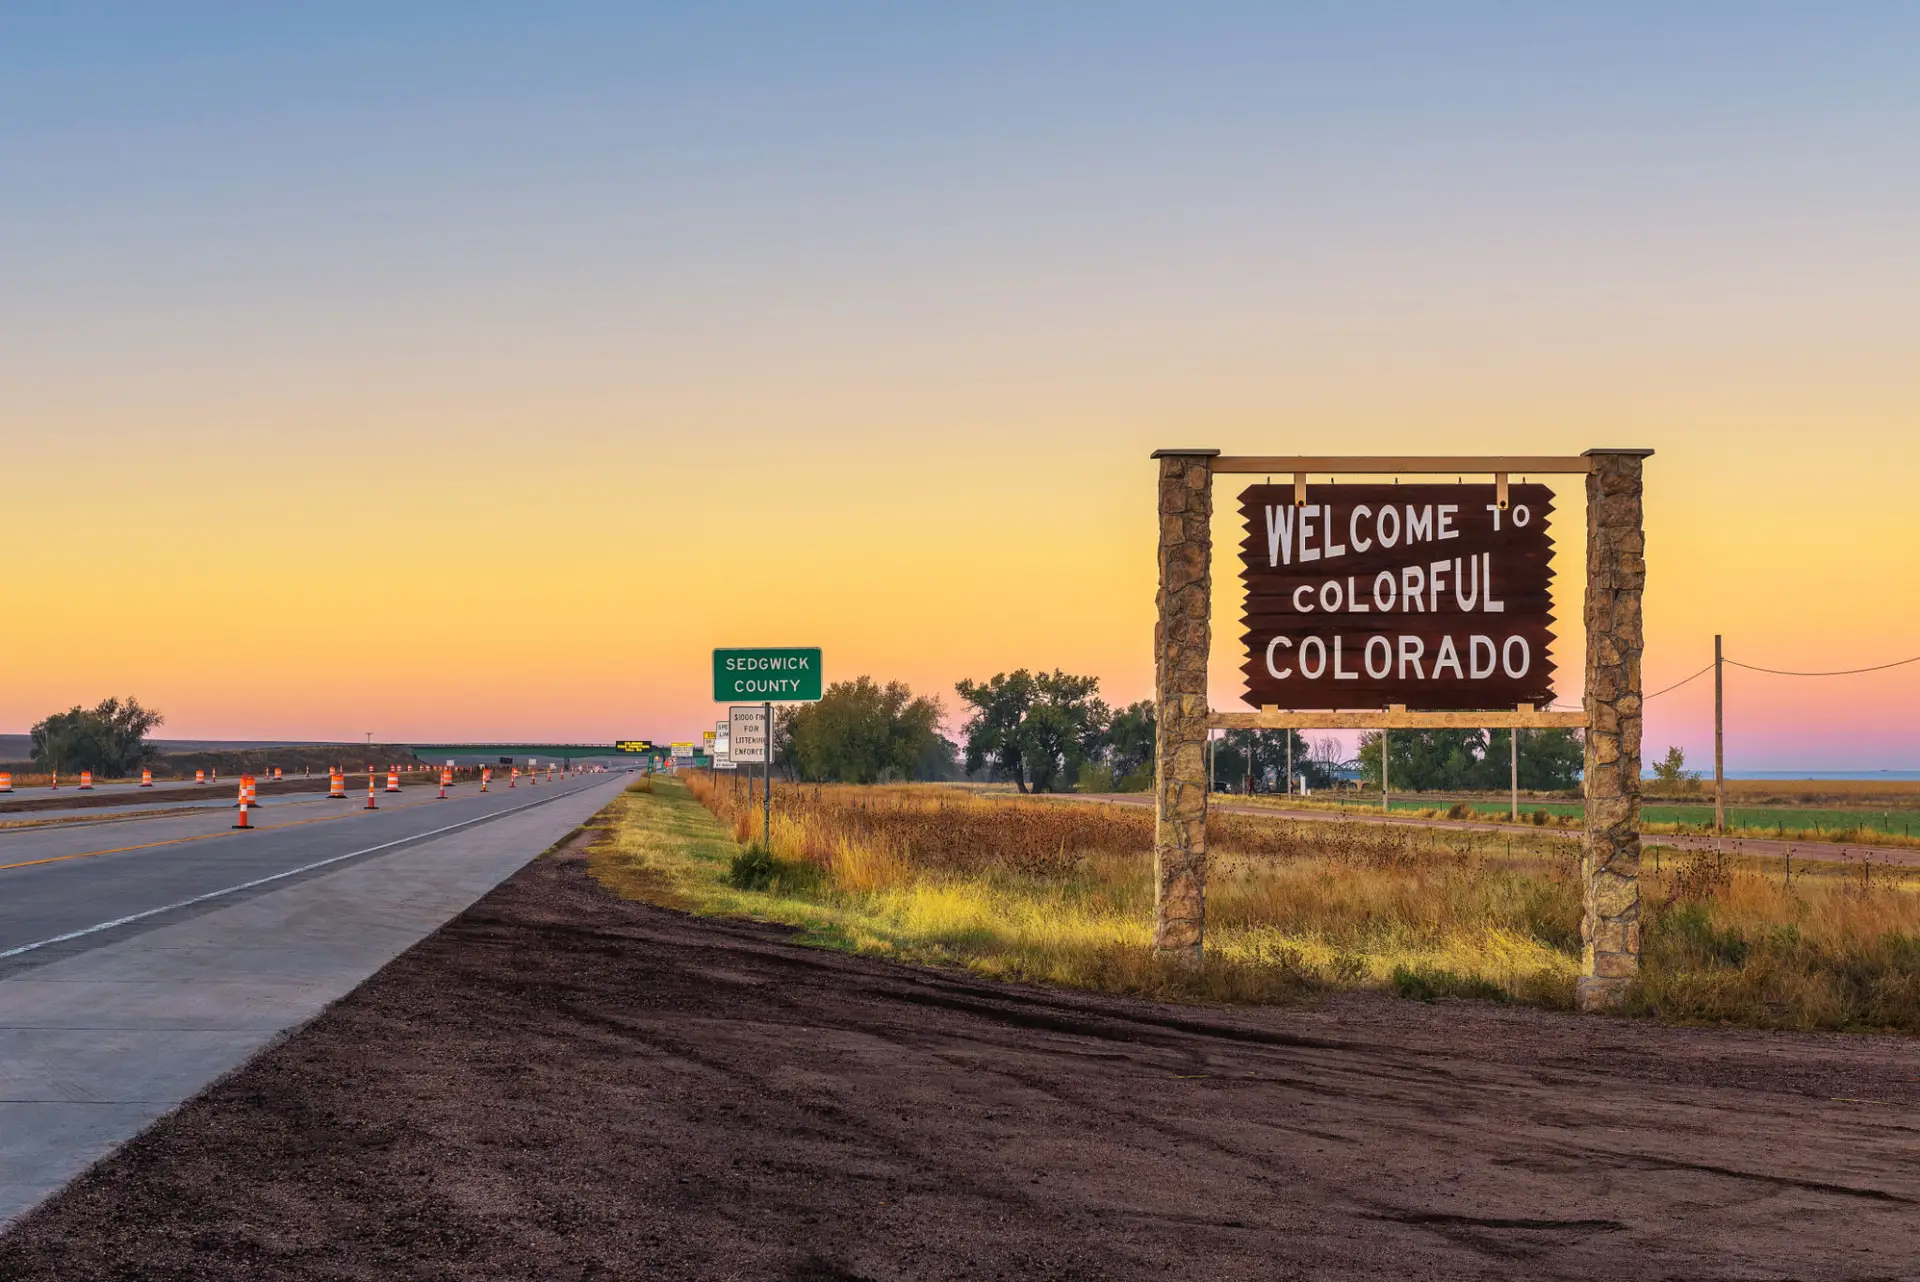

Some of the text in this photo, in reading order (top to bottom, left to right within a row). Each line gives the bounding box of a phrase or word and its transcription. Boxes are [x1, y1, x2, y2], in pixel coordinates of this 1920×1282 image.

[1265, 504, 1531, 567] WELCOME TO
[1293, 552, 1504, 612] COLORFUL
[725, 657, 809, 671] SEDGWICK
[1265, 635, 1531, 679] COLORADO
[734, 679, 801, 692] COUNTY
[734, 713, 754, 721] $1000
